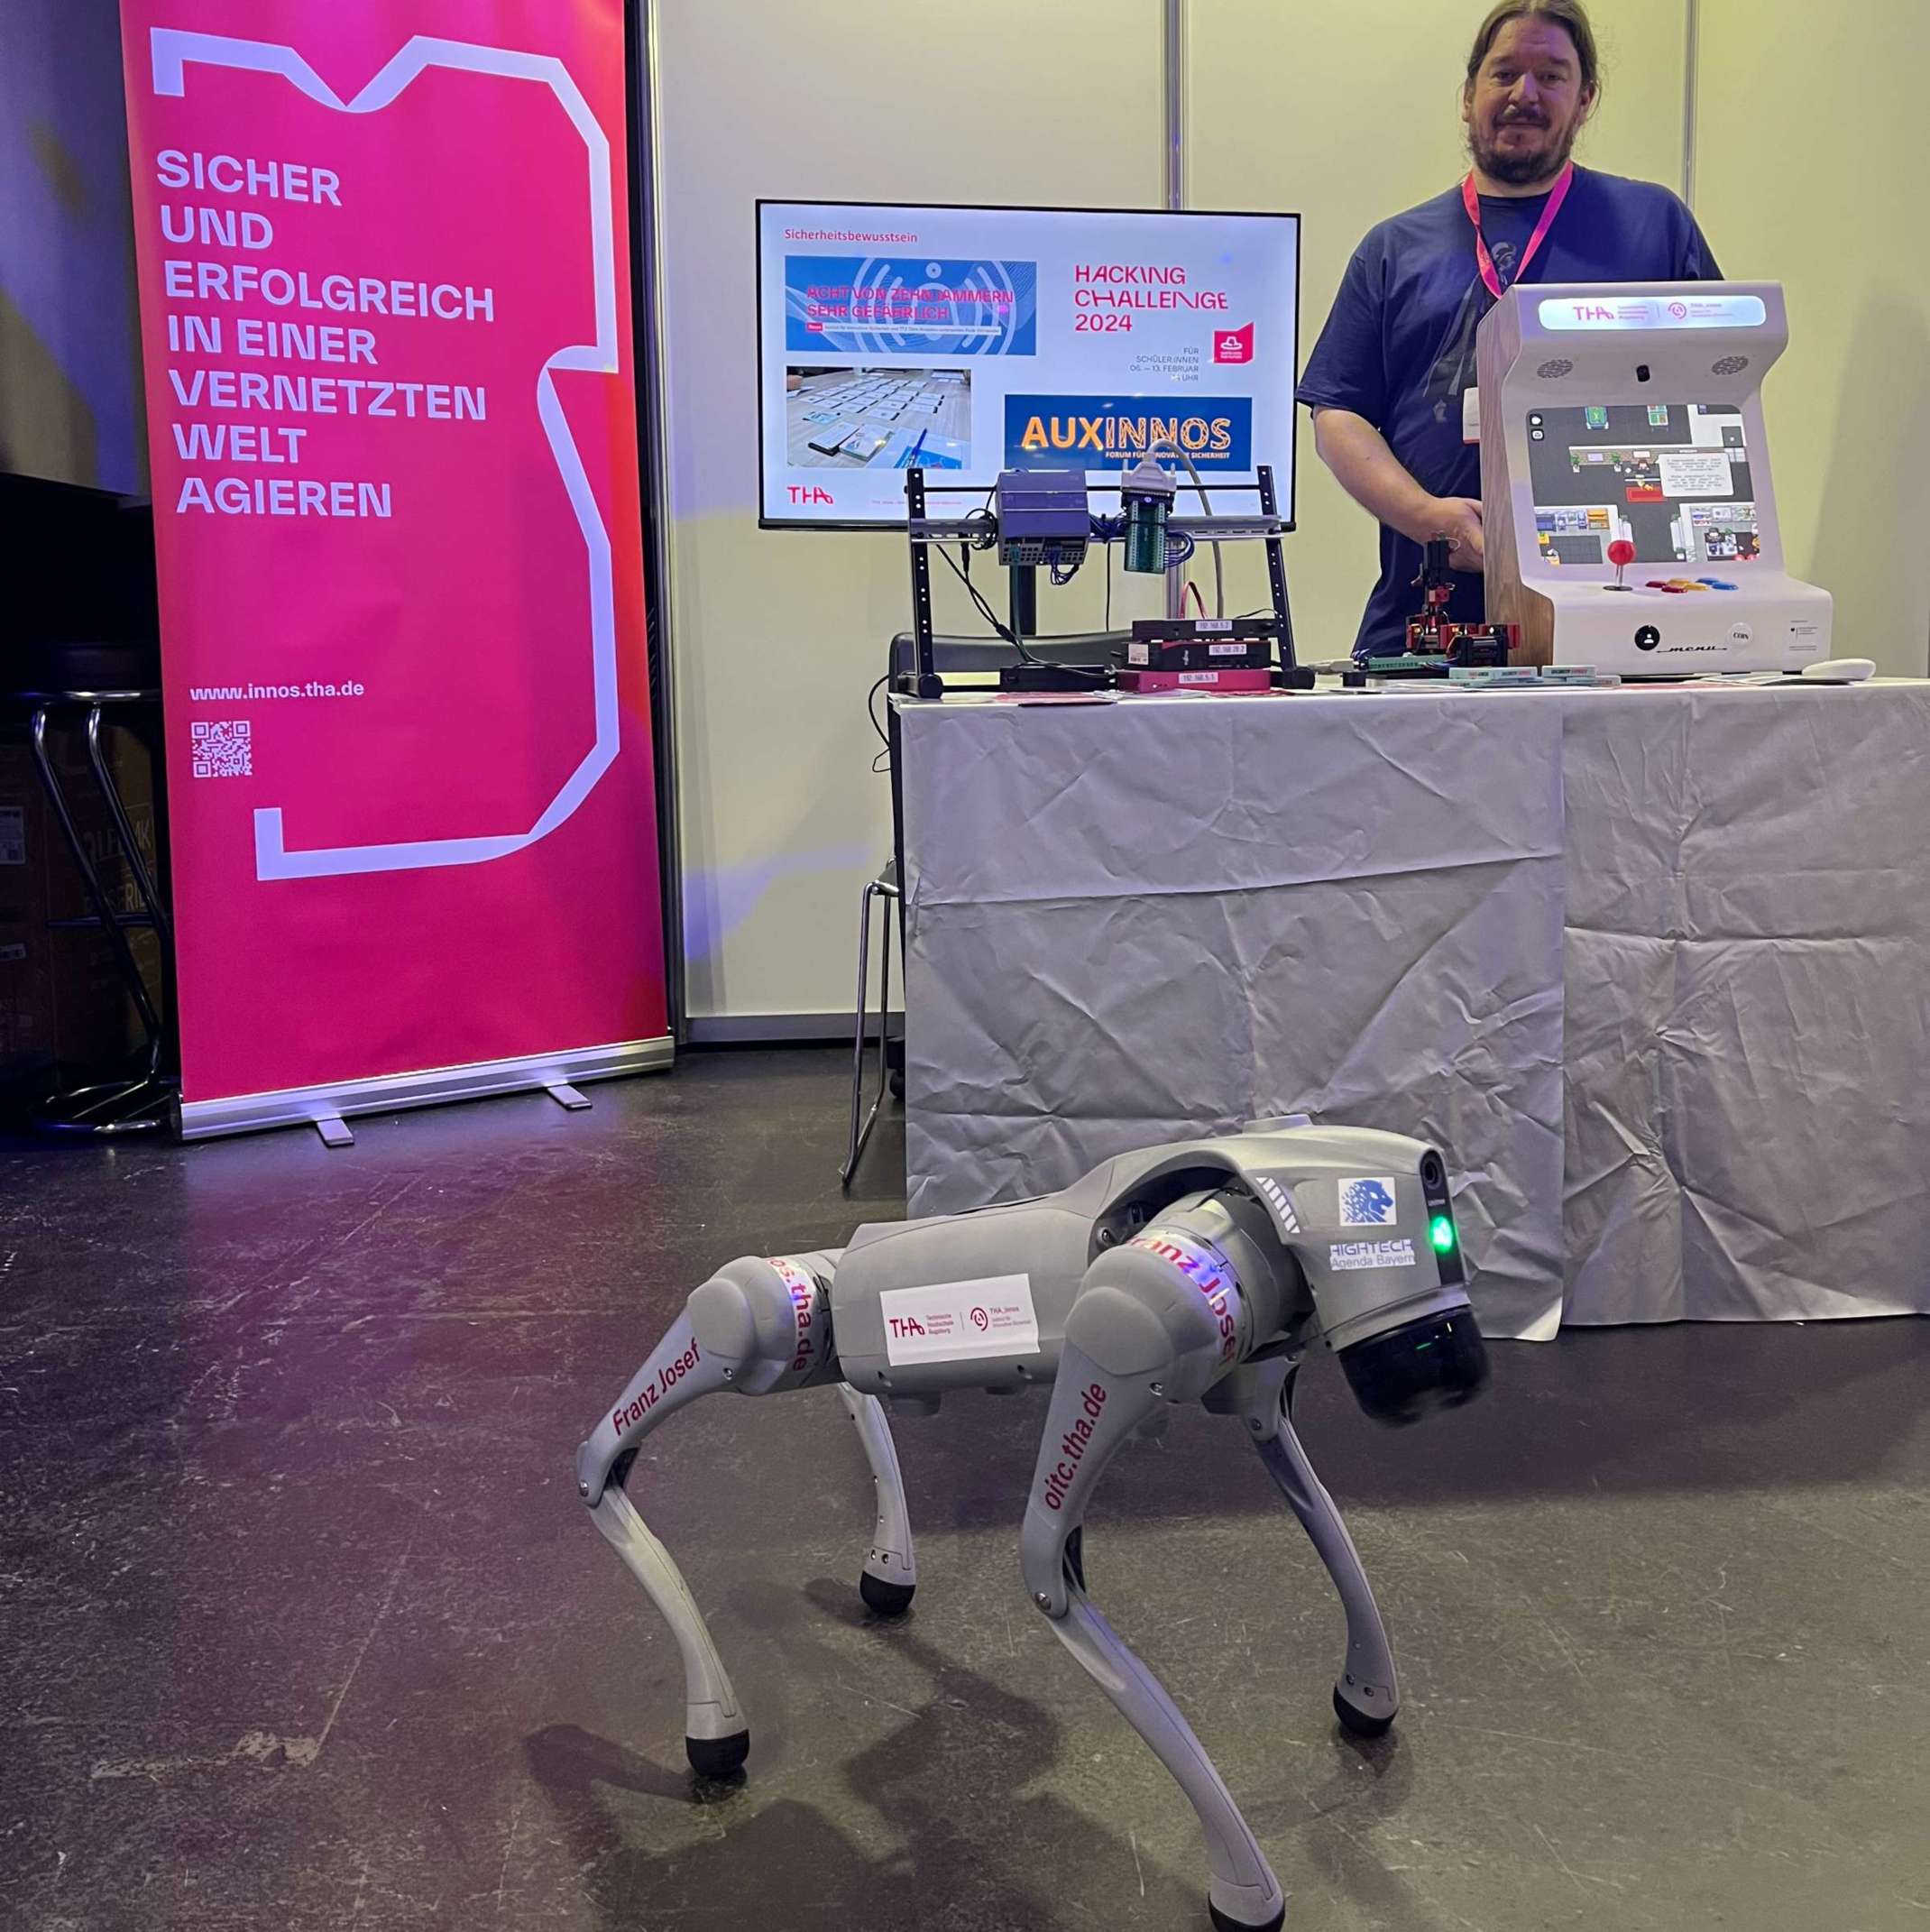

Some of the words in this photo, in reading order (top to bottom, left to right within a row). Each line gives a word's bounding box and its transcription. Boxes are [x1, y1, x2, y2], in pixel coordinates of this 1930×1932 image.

[156, 149, 343, 207] SICHER
[160, 204, 274, 250] UND
[784, 229, 918, 244] Sicherheitsbewusstsein
[1074, 264, 1186, 285] HACKING
[163, 260, 495, 322] ERFOLGREICH
[807, 285, 848, 299] ACHT
[851, 286, 887, 300] VON
[890, 287, 931, 301] ZEHN
[1074, 289, 1229, 309] CHALLENGE
[807, 303, 848, 317] SEHR
[1074, 313, 1134, 333] 2024
[167, 314, 222, 354] IN
[236, 317, 379, 365] EINER
[1183, 346, 1199, 354] FÜR
[1163, 364, 1199, 373] FEBRUAR
[169, 368, 488, 421] VERNETZTEN
[171, 422, 308, 464] WELT
[1020, 416, 1233, 450] AUXINNOS
[1105, 451, 1132, 459] FORUM
[1190, 451, 1231, 459] SICHERHEIT
[176, 476, 392, 519] AGIEREN
[786, 485, 834, 505] THA
[189, 680, 365, 702] www.innos.tha.de
[1329, 1239, 1415, 1256] HIGHTECH
[1330, 1255, 1374, 1270] Agenda
[1376, 1253, 1414, 1267] Bayern
[767, 1256, 815, 1372] os.tha.de
[888, 1317, 925, 1339] THA
[611, 1382, 659, 1437] Franz
[658, 1337, 702, 1394] Josef
[1043, 1383, 1107, 1511] oitc.tha.de
